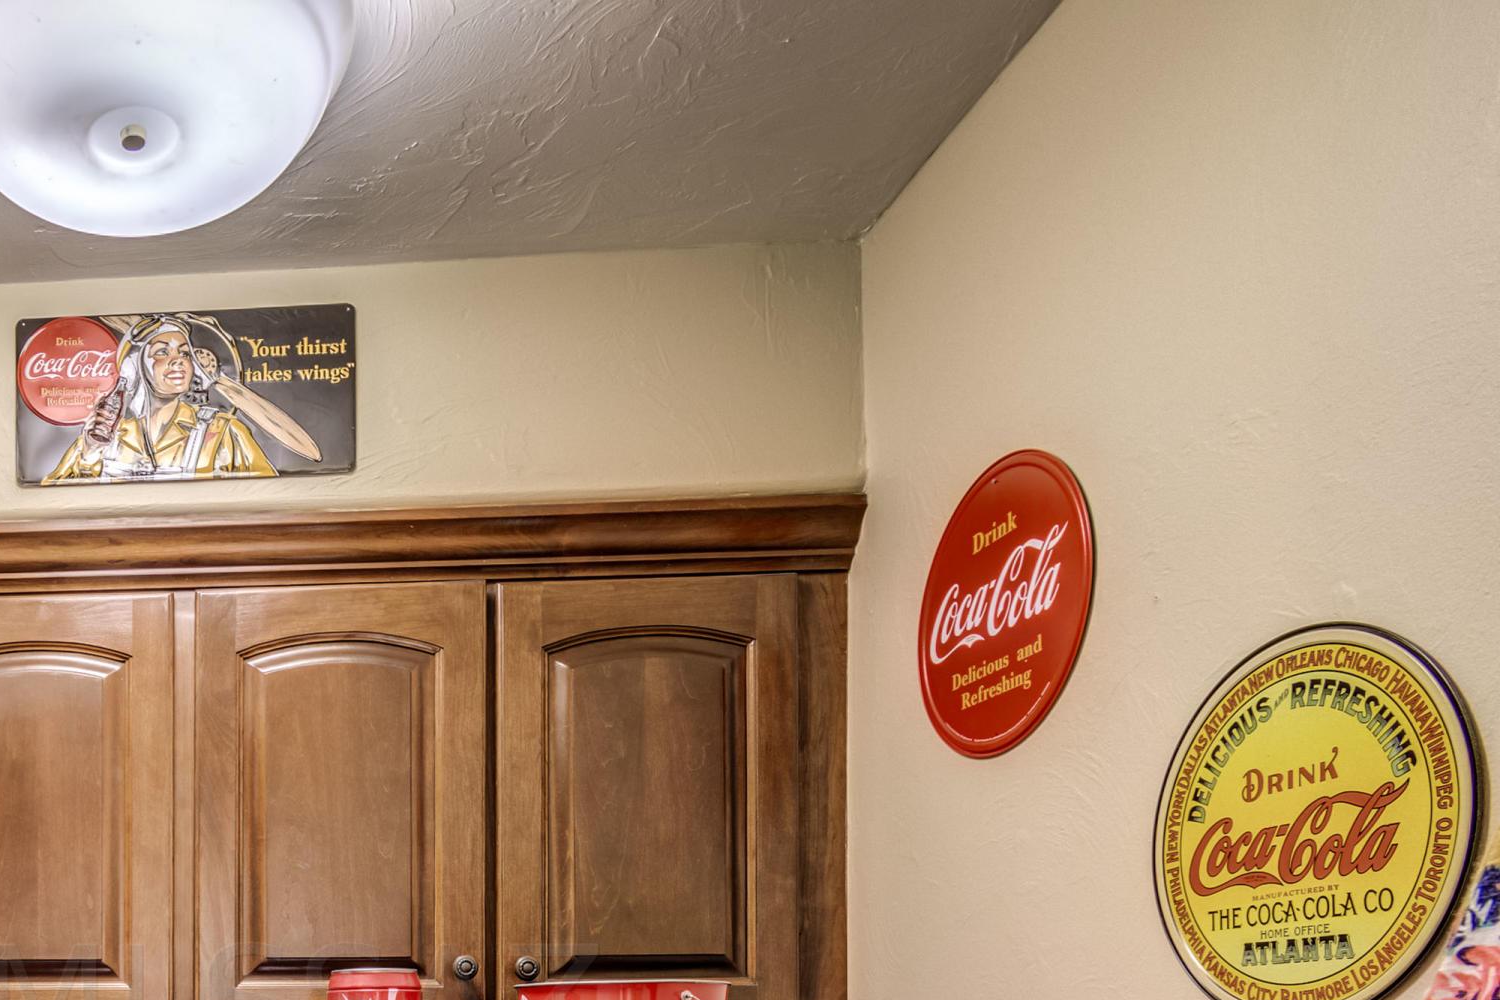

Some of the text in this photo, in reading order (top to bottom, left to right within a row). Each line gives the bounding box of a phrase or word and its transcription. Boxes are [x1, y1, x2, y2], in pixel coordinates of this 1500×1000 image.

[55, 337, 84, 346] Drink
[296, 336, 347, 355] thirst
[24, 350, 116, 380] Coca-Cola
[245, 362, 292, 383] takes
[972, 510, 1018, 555] Drink
[929, 520, 1068, 665] Coca-Cola
[951, 633, 1043, 692] Delicious and
[960, 669, 1032, 710] Refreshing
[1178, 734, 1208, 789] DALLAS
[1204, 687, 1250, 740] ATLANTA
[1248, 667, 1274, 693] NEW
[1275, 649, 1333, 678] ORLEANS
[1334, 647, 1390, 682] CHICAGO
[1385, 669, 1435, 730] HAVANA
[1420, 716, 1454, 810] WINNIPEG
[1187, 696, 1273, 824] DELICIOUS
[1290, 678, 1417, 778] REFRESHING
[1242, 746, 1339, 803] DRINK
[1189, 777, 1410, 897] Coca-Cola
[1415, 817, 1453, 902] TORONTO
[1208, 907, 1242, 931] THE
[1364, 887, 1394, 913] CO
[1252, 884, 1340, 901] MANUFACTURED BY
[1167, 866, 1206, 960] PHILADELPHIA
[1201, 950, 1246, 996] KANSAS
[1350, 959, 1379, 989] LOS
[1373, 902, 1428, 971] ANGELES
[1241, 933, 1355, 967] ATLANTA
[1260, 924, 1330, 940] HOME OFFICE
